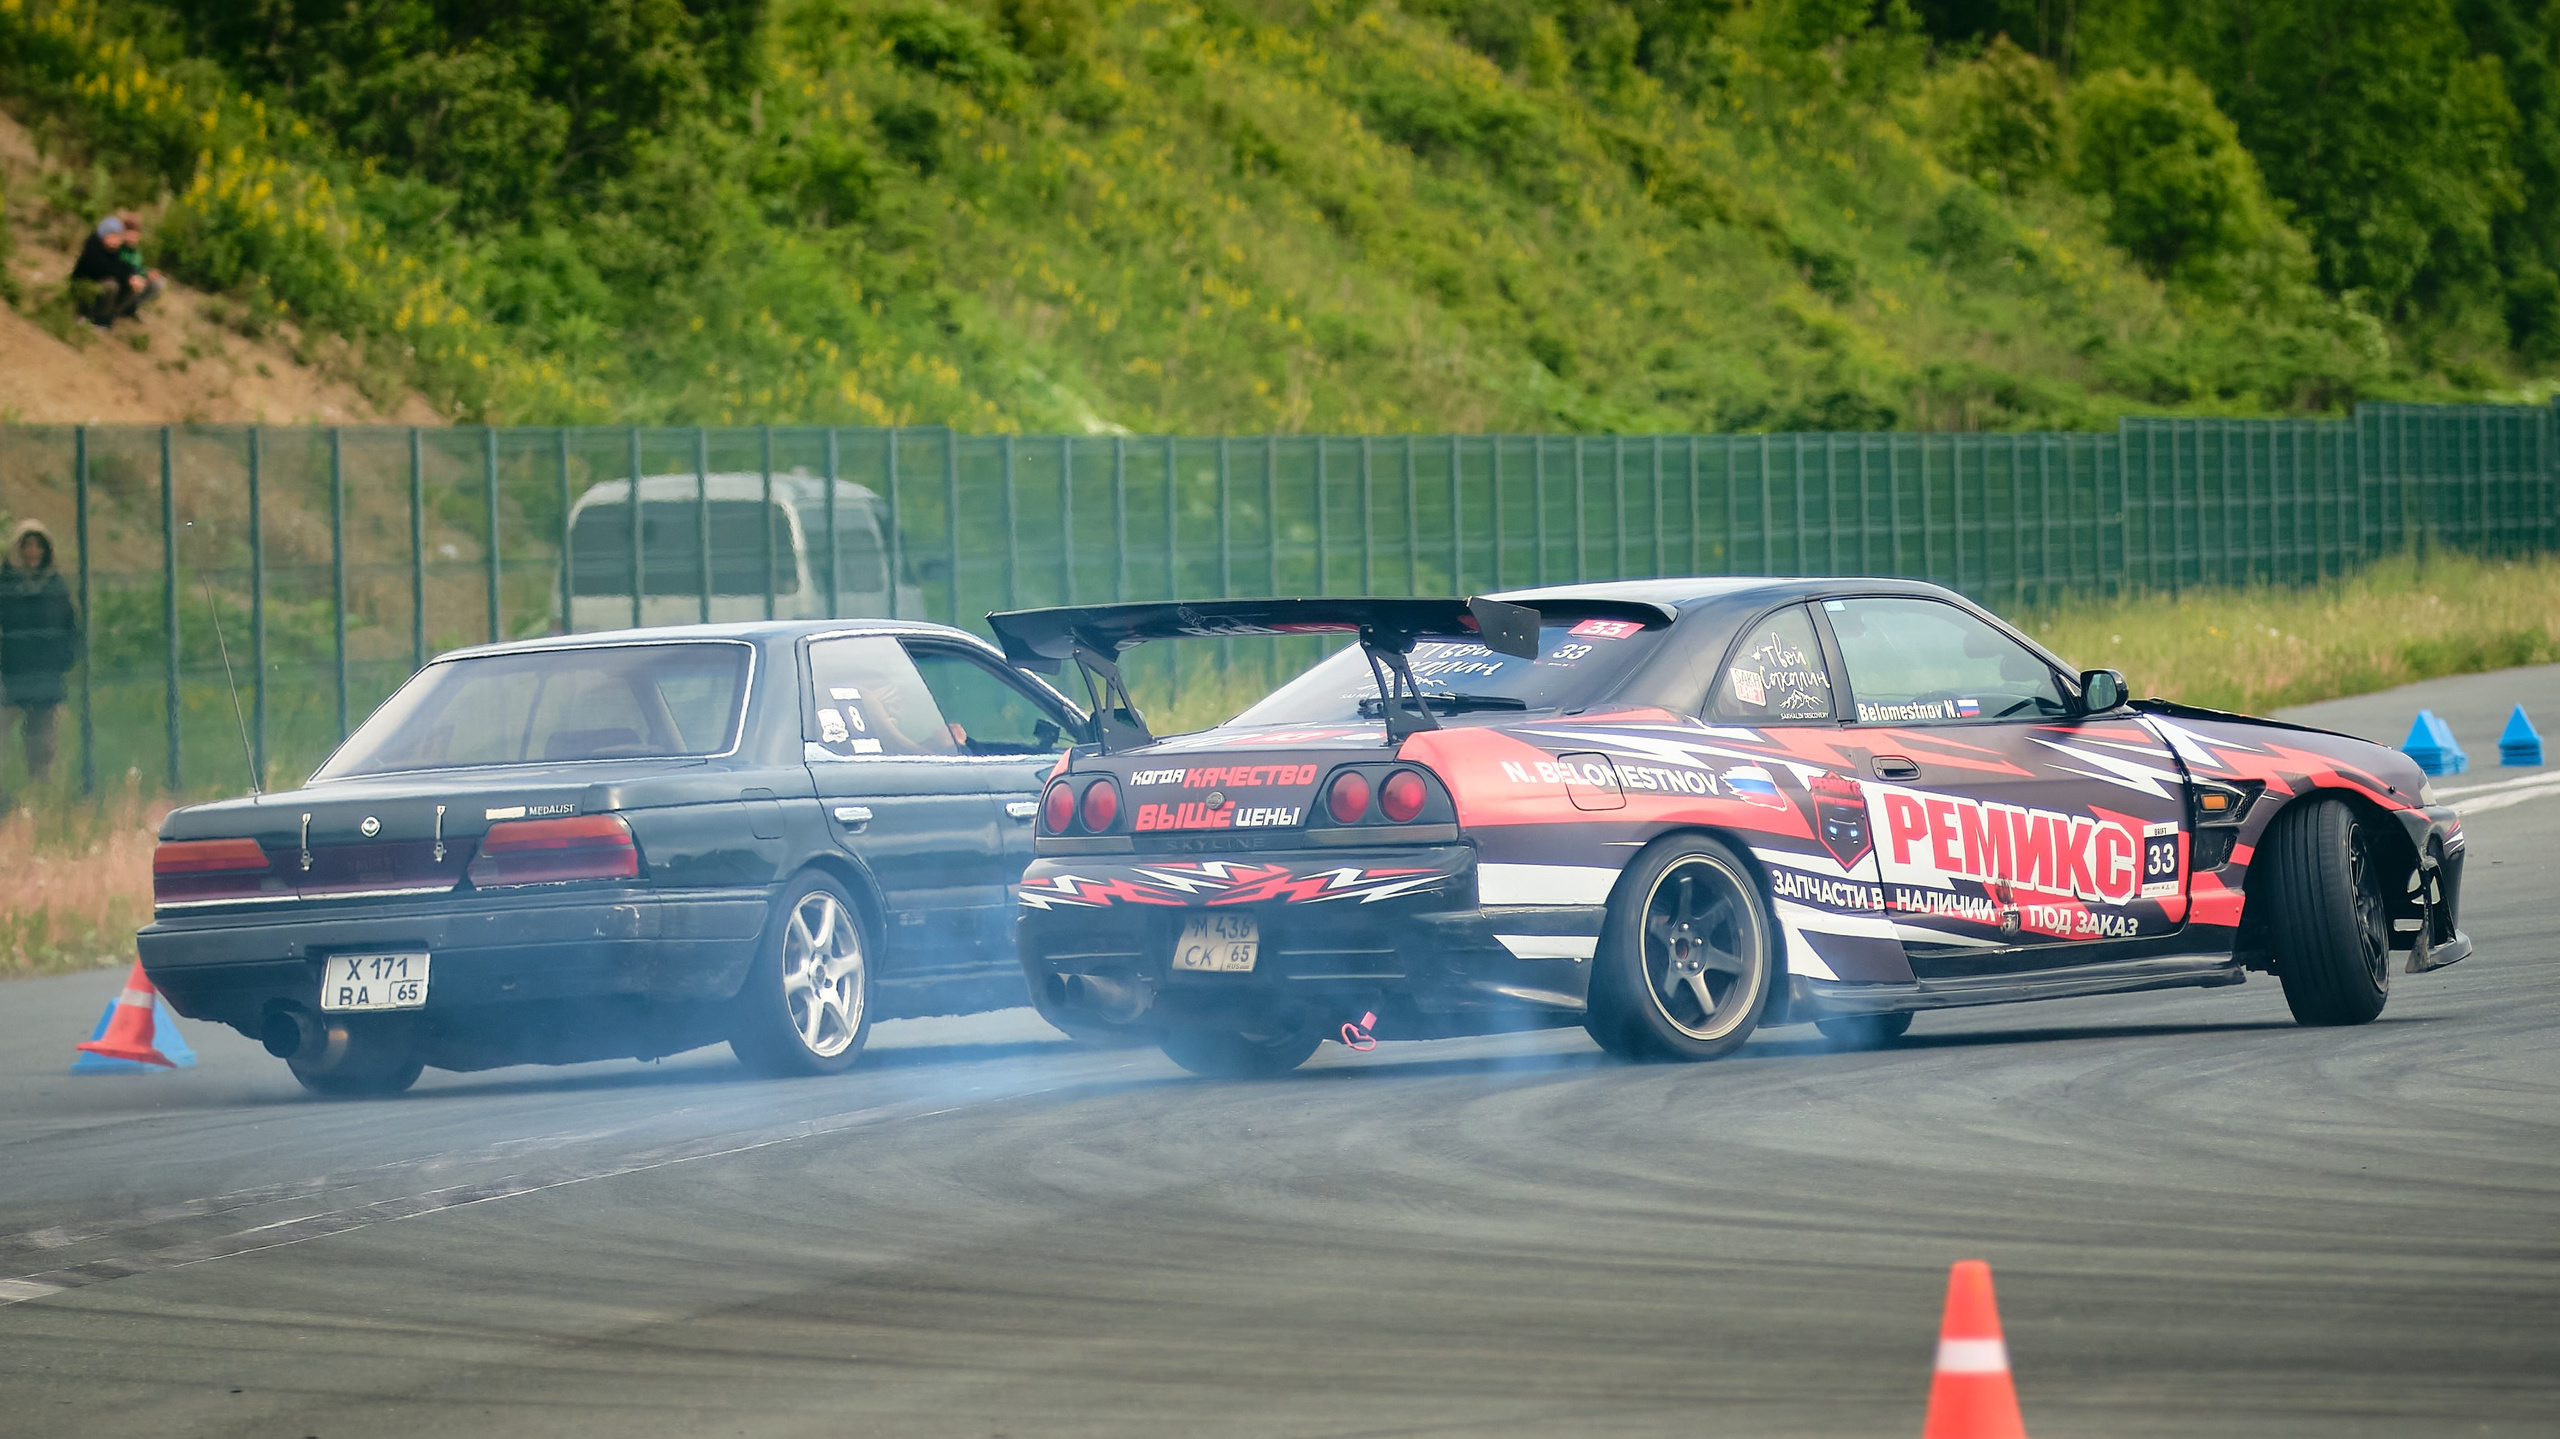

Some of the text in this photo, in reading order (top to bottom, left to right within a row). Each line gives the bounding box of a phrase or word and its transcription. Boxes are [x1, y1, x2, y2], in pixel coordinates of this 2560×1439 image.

[1582, 621, 1628, 636] 33
[1552, 643, 1593, 660] 33
[1761, 631, 1807, 668] Твой
[1759, 664, 1831, 693] Сахалин
[848, 705, 866, 733] 8
[1857, 699, 1961, 722] Belomestnov N.
[1129, 764, 1318, 789] КОГДА КАЧЕСТВО
[1502, 761, 1719, 796] N. BELOMESTNOV
[529, 803, 575, 816] MEDALIST
[1135, 801, 1301, 831] ВЫШЕ ЦЕНЫ
[1167, 837, 1266, 851] SKYLINE
[1883, 792, 2135, 903] РЕМИКС
[2148, 843, 2175, 875] 33
[1773, 869, 1869, 910] ЗАПЧАСТИ
[1871, 886, 1885, 911] В
[1896, 888, 1996, 922] НАЛИЧИИ
[2029, 904, 2072, 935] ПОД
[2074, 914, 2139, 937] ЗАКАЗ
[1185, 944, 1251, 967] СК 65
[370, 957, 408, 980] 171
[397, 983, 418, 1001] 65
